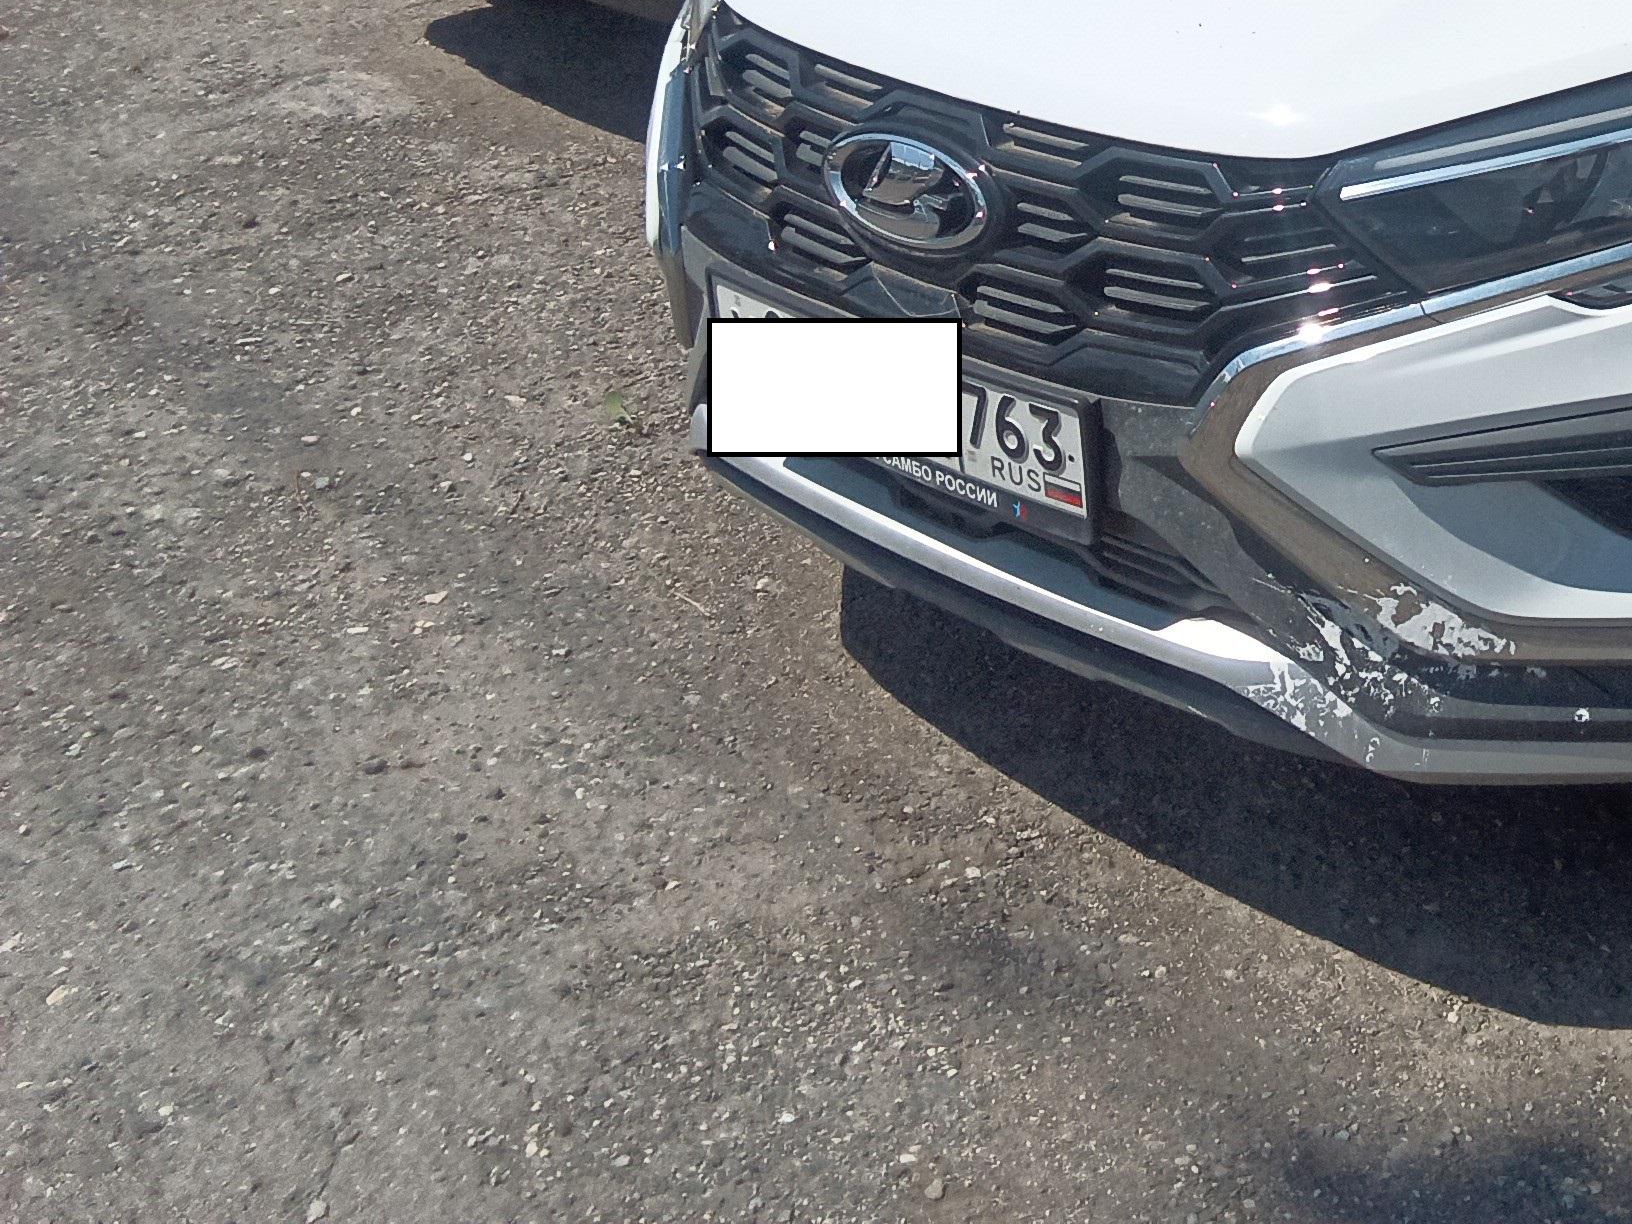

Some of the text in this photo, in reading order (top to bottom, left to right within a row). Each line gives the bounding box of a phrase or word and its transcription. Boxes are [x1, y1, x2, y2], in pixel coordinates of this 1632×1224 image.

[962, 382, 1065, 473] 763
[936, 470, 998, 508] РОССИИ
[991, 456, 1041, 492] RUS
